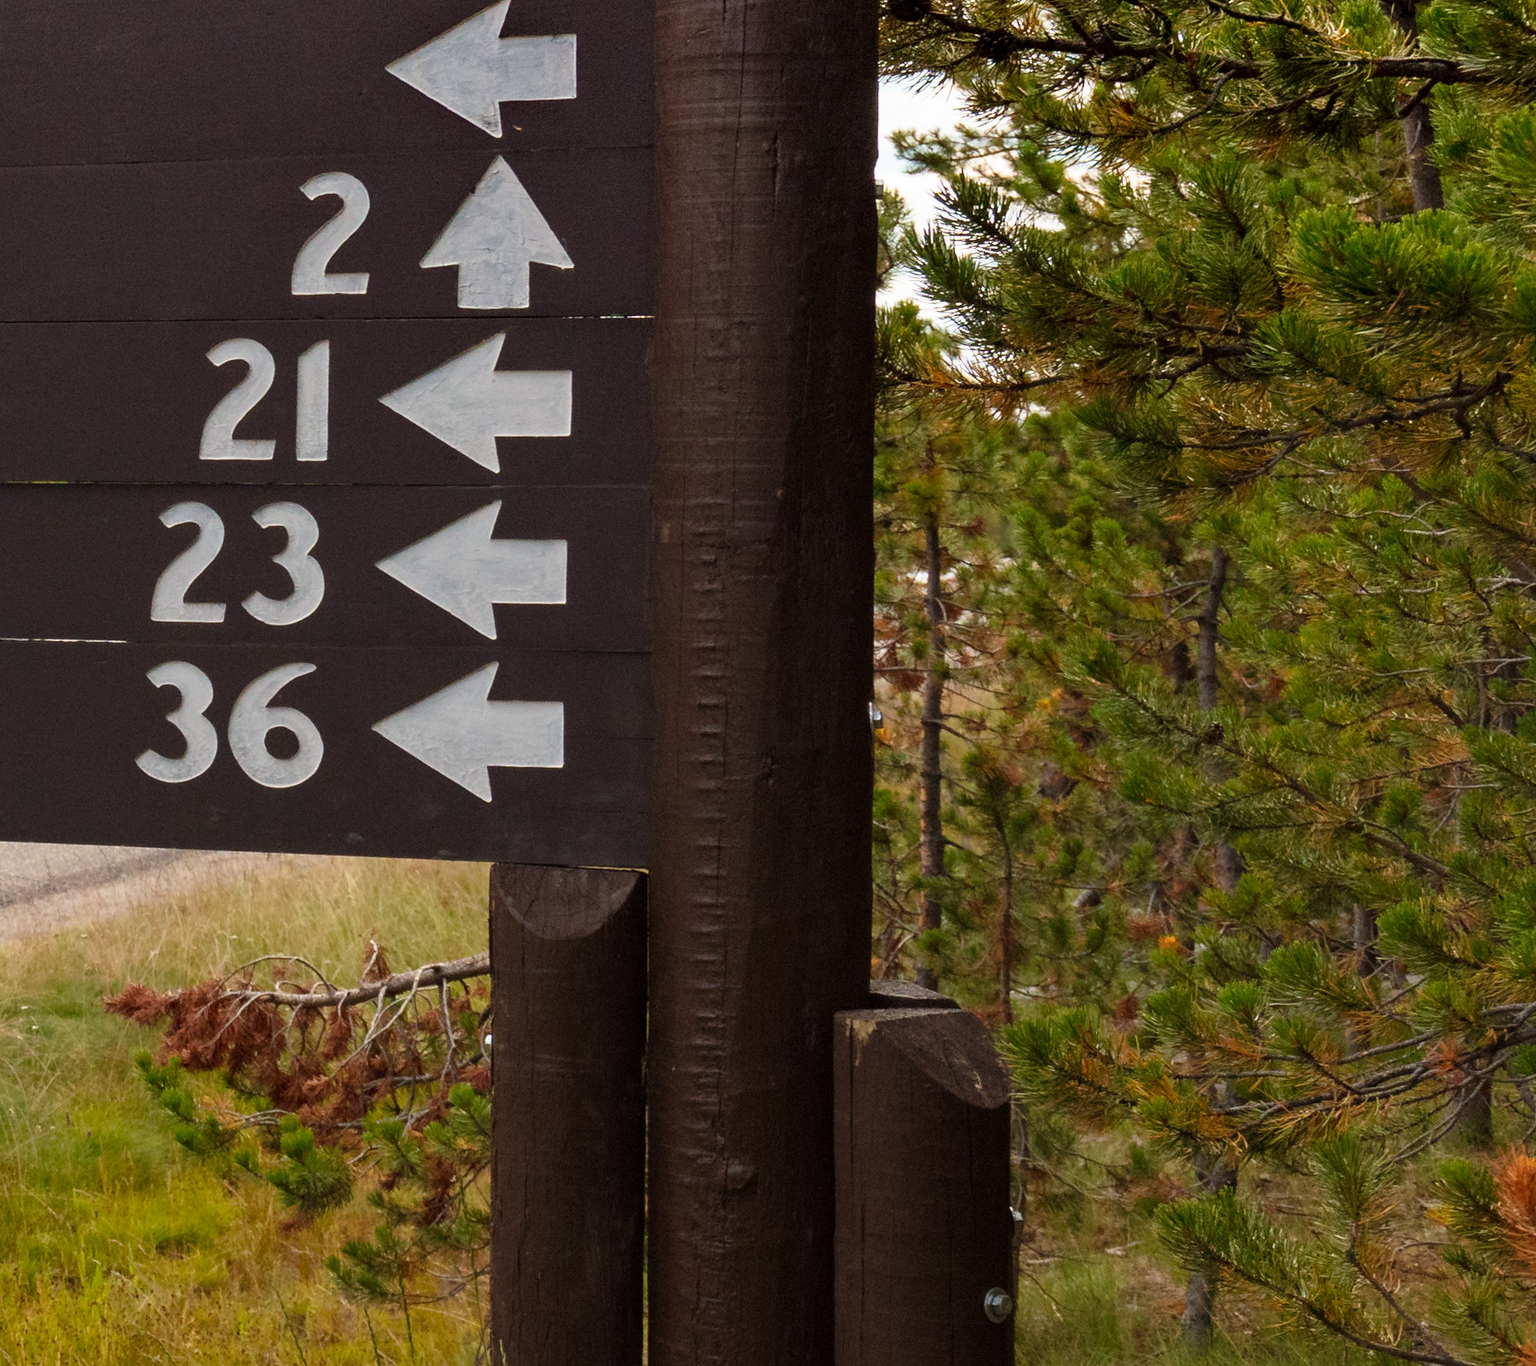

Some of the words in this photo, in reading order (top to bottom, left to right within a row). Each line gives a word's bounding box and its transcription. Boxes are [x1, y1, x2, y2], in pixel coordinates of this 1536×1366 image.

[291, 172, 371, 296] 2
[199, 338, 330, 462] 21
[150, 502, 325, 626] 23
[135, 662, 325, 789] 36
